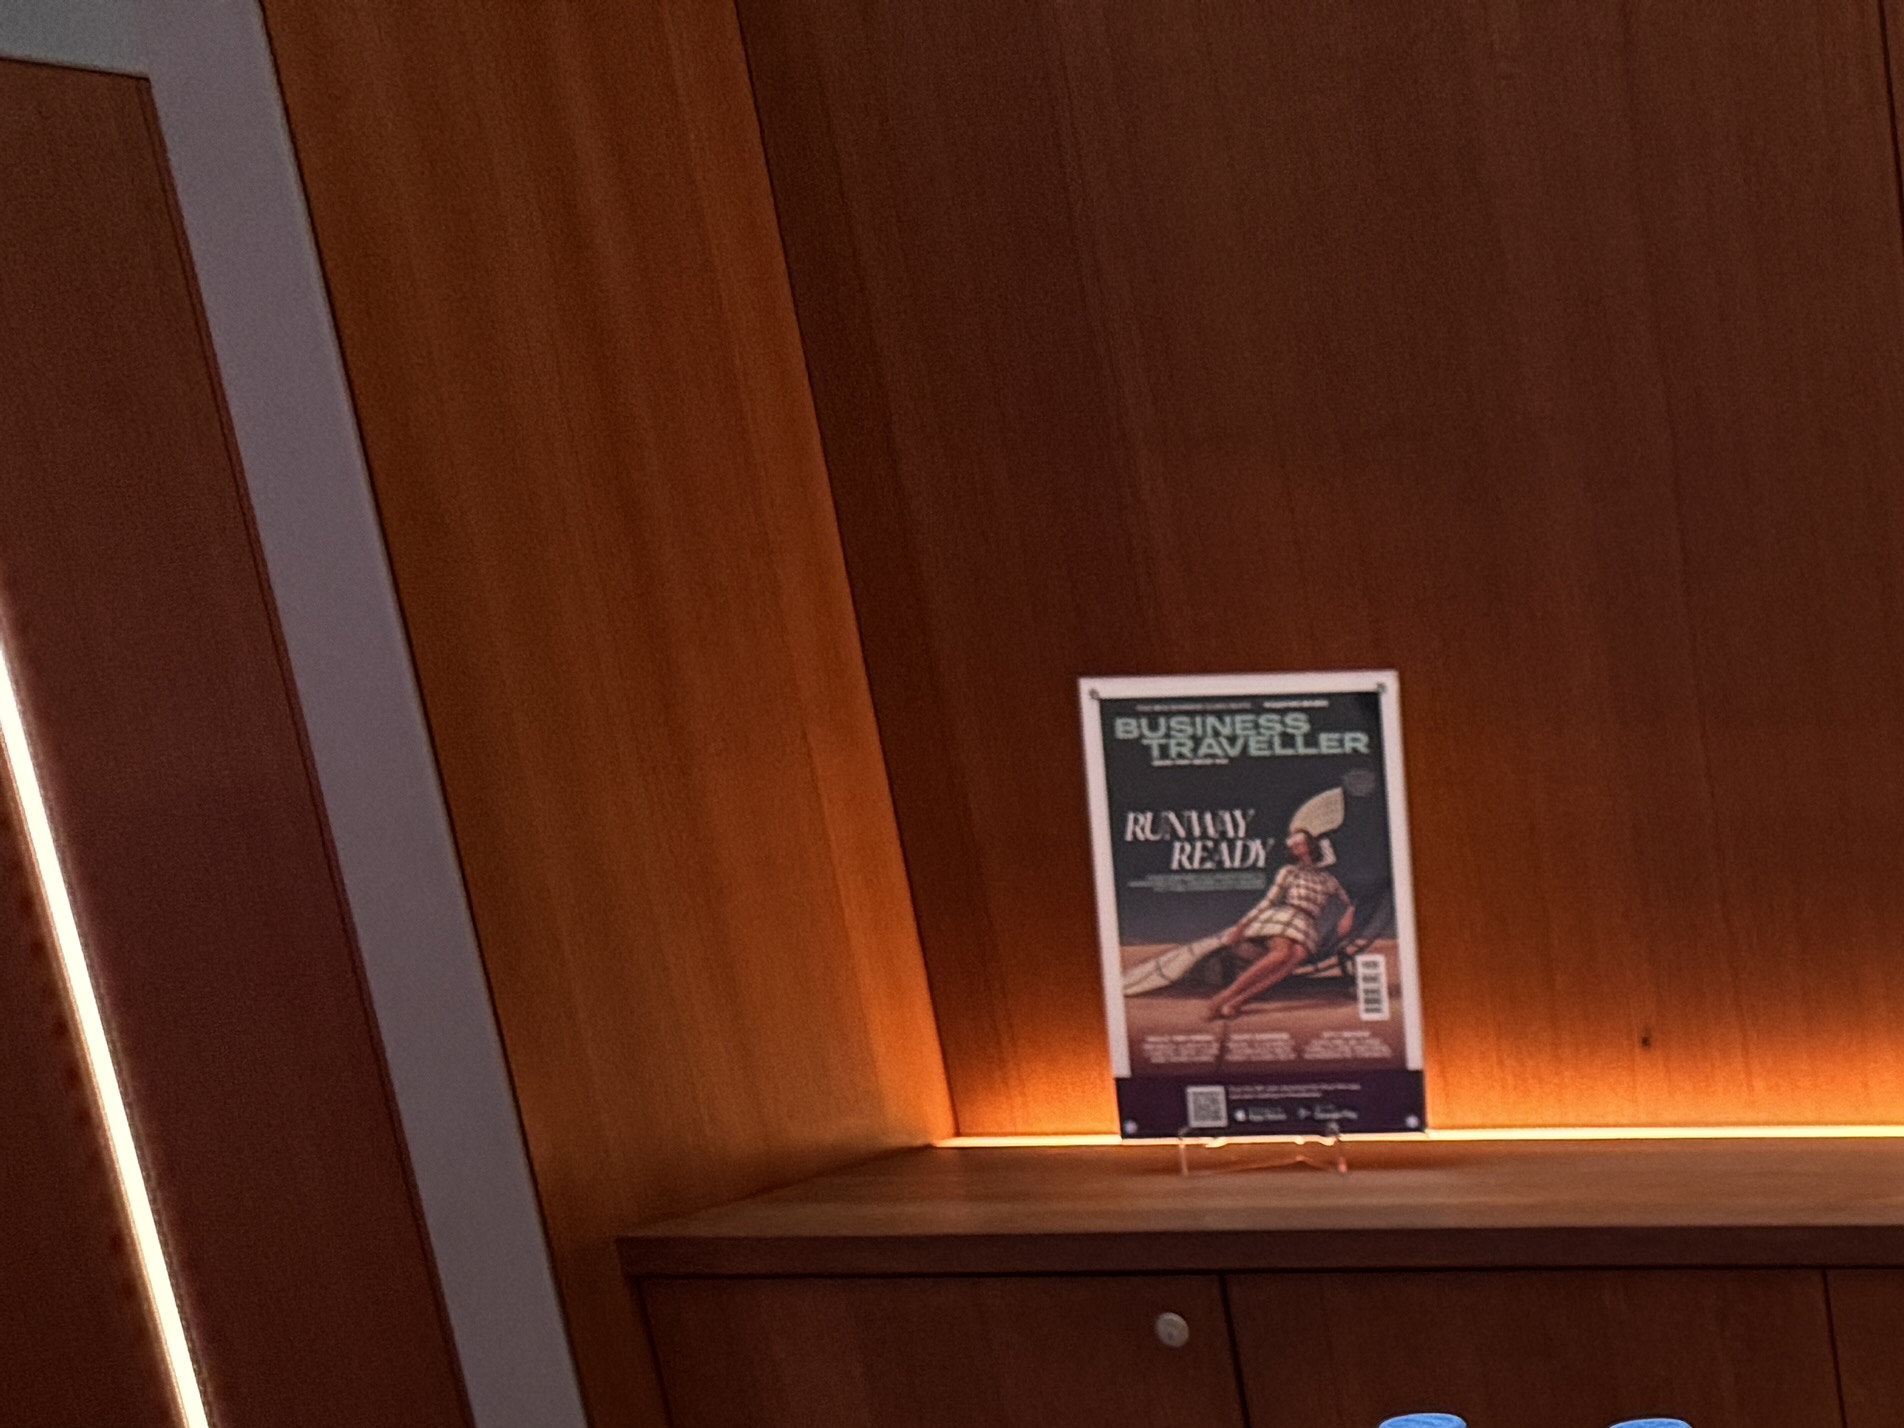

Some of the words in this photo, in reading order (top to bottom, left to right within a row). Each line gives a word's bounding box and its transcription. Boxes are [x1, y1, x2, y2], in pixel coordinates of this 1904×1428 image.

[1114, 712, 1311, 740] BUSINESS
[1142, 732, 1370, 760] TRAVELLER
[1124, 808, 1255, 841] RUNWAY
[1170, 838, 1274, 871] READY
